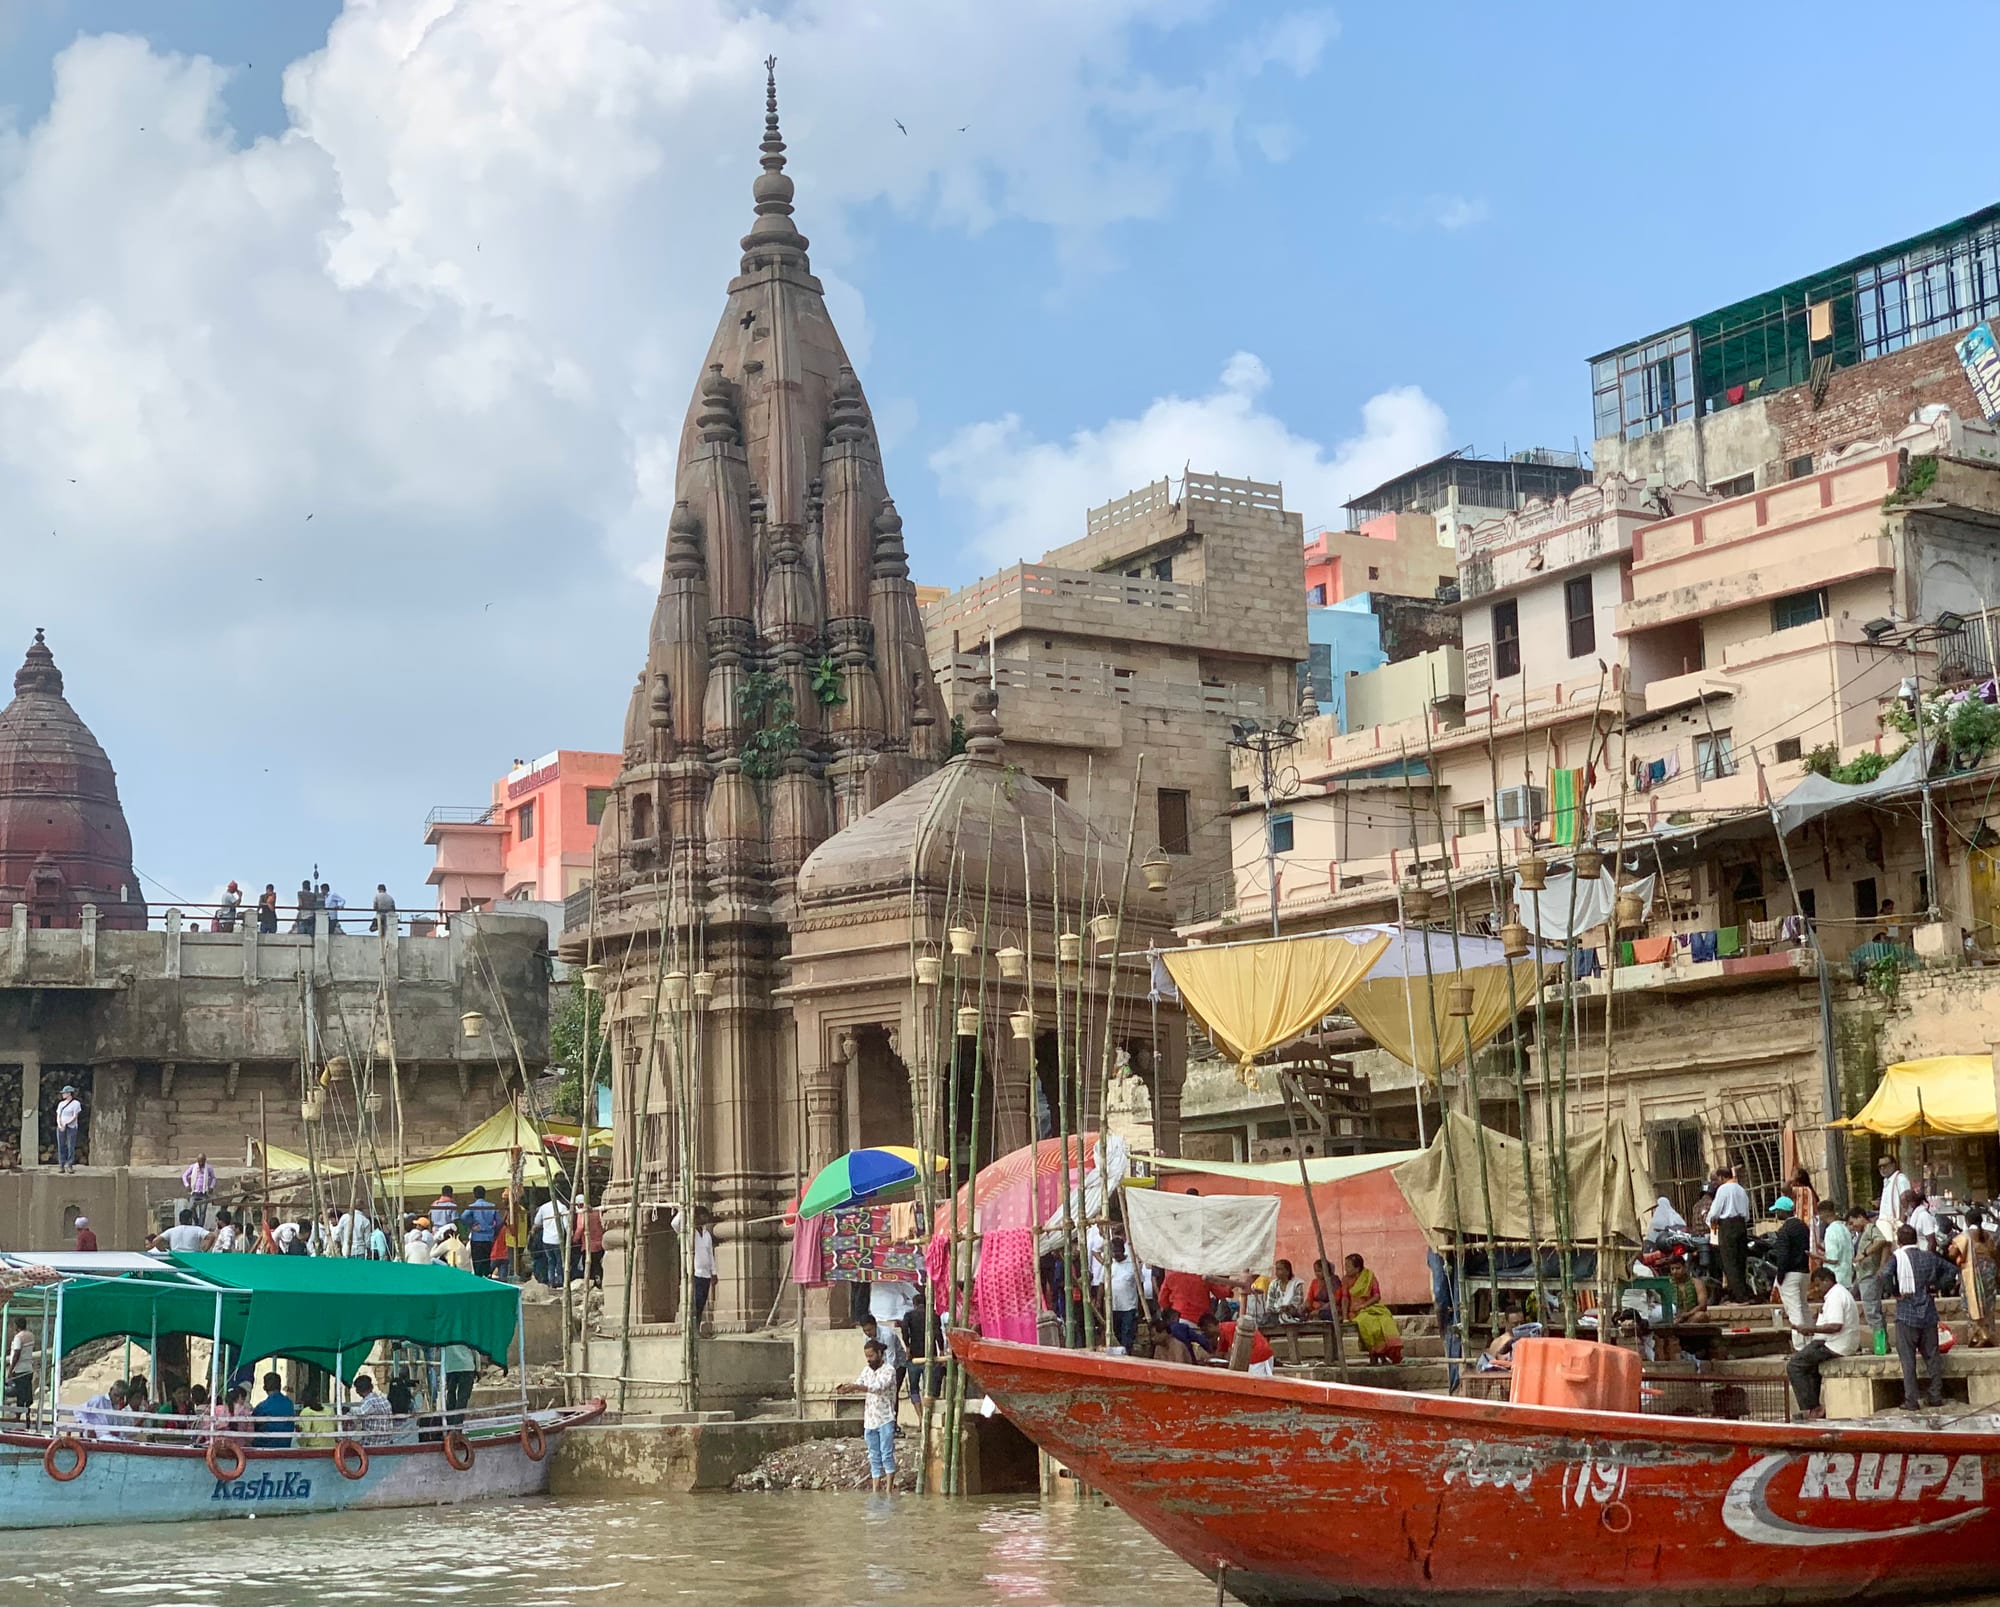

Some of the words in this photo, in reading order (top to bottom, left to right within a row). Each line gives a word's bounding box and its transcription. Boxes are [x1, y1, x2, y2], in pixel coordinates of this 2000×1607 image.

[1965, 363, 1983, 392] GUEST
[1976, 389, 1995, 420] HOUSE
[1974, 346, 2000, 414] KAS
[1799, 1452, 1983, 1501] RUPA
